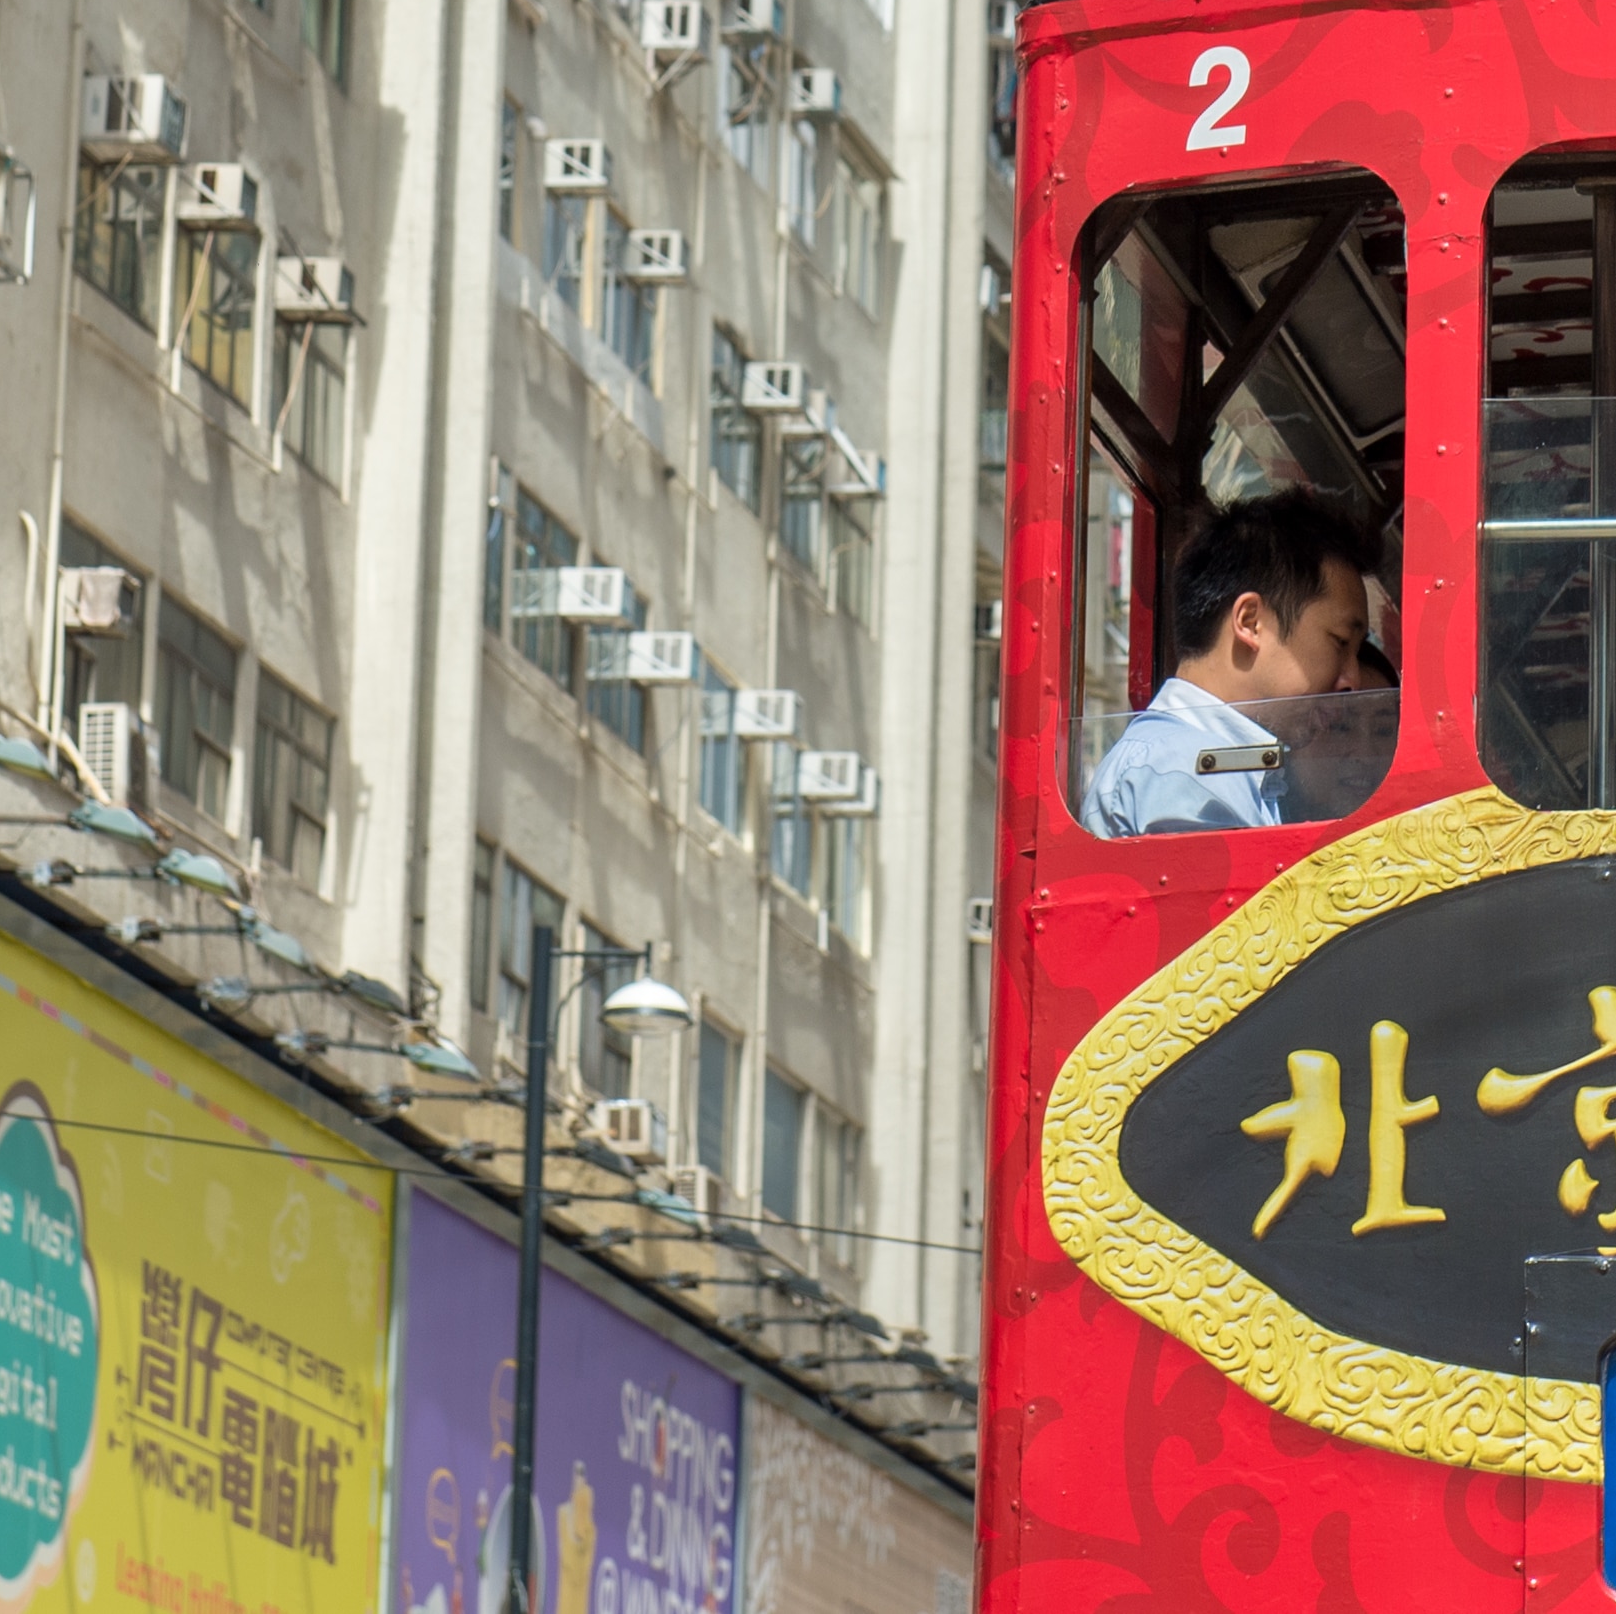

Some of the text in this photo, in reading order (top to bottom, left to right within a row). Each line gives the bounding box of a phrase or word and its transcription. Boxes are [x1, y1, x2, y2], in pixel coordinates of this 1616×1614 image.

[1184, 46, 1252, 152] 2
[21, 1189, 76, 1267] Most
[617, 1379, 735, 1514] SHOPPING
